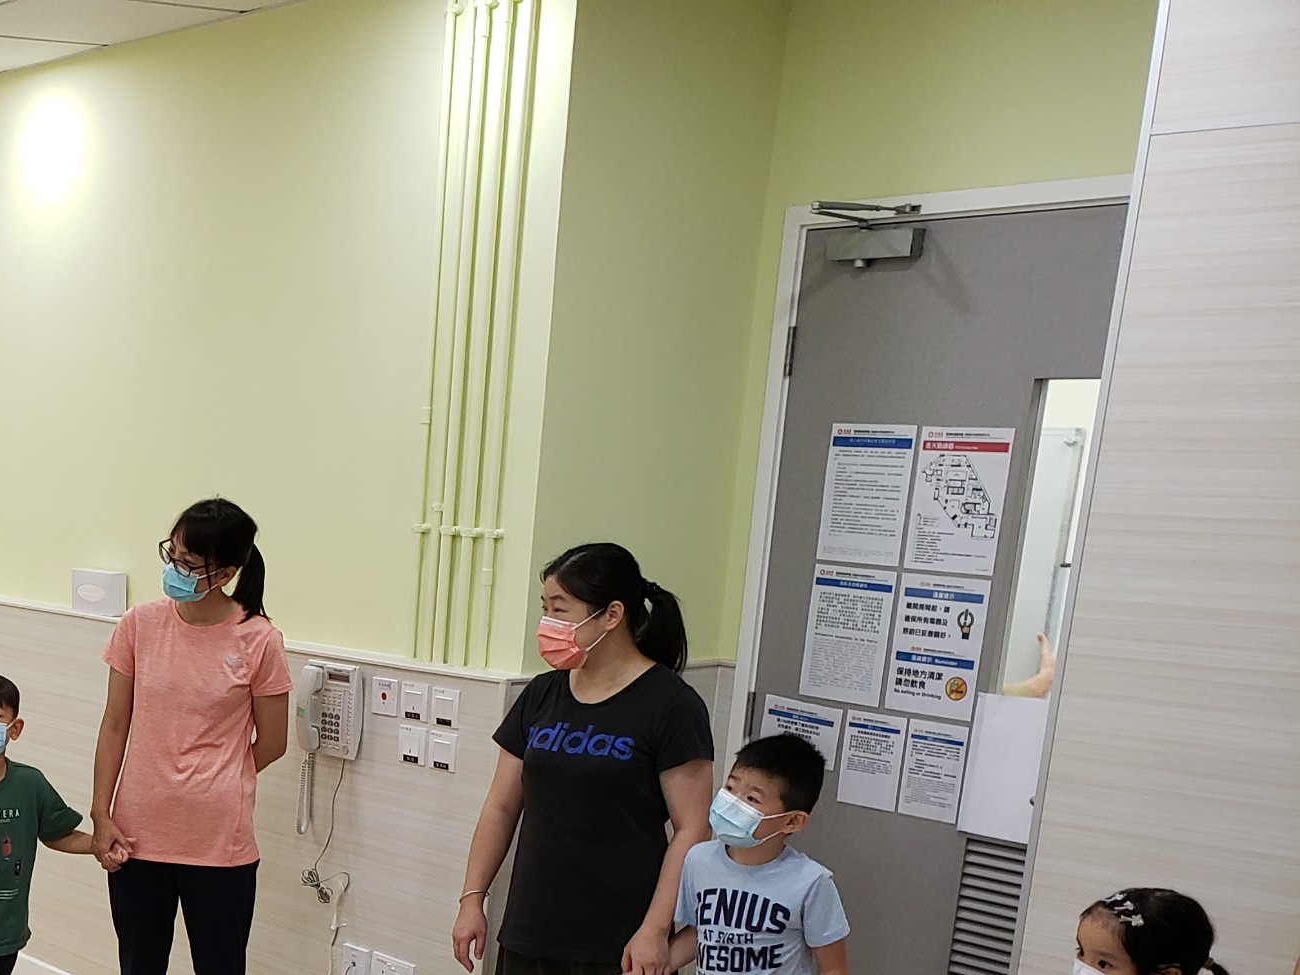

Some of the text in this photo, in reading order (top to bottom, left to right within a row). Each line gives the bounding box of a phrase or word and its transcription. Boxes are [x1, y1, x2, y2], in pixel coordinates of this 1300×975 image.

[896, 667, 943, 680] 保持地方清潔
[895, 677, 926, 690] 請勿飲食
[696, 942, 784, 973] WESOME
